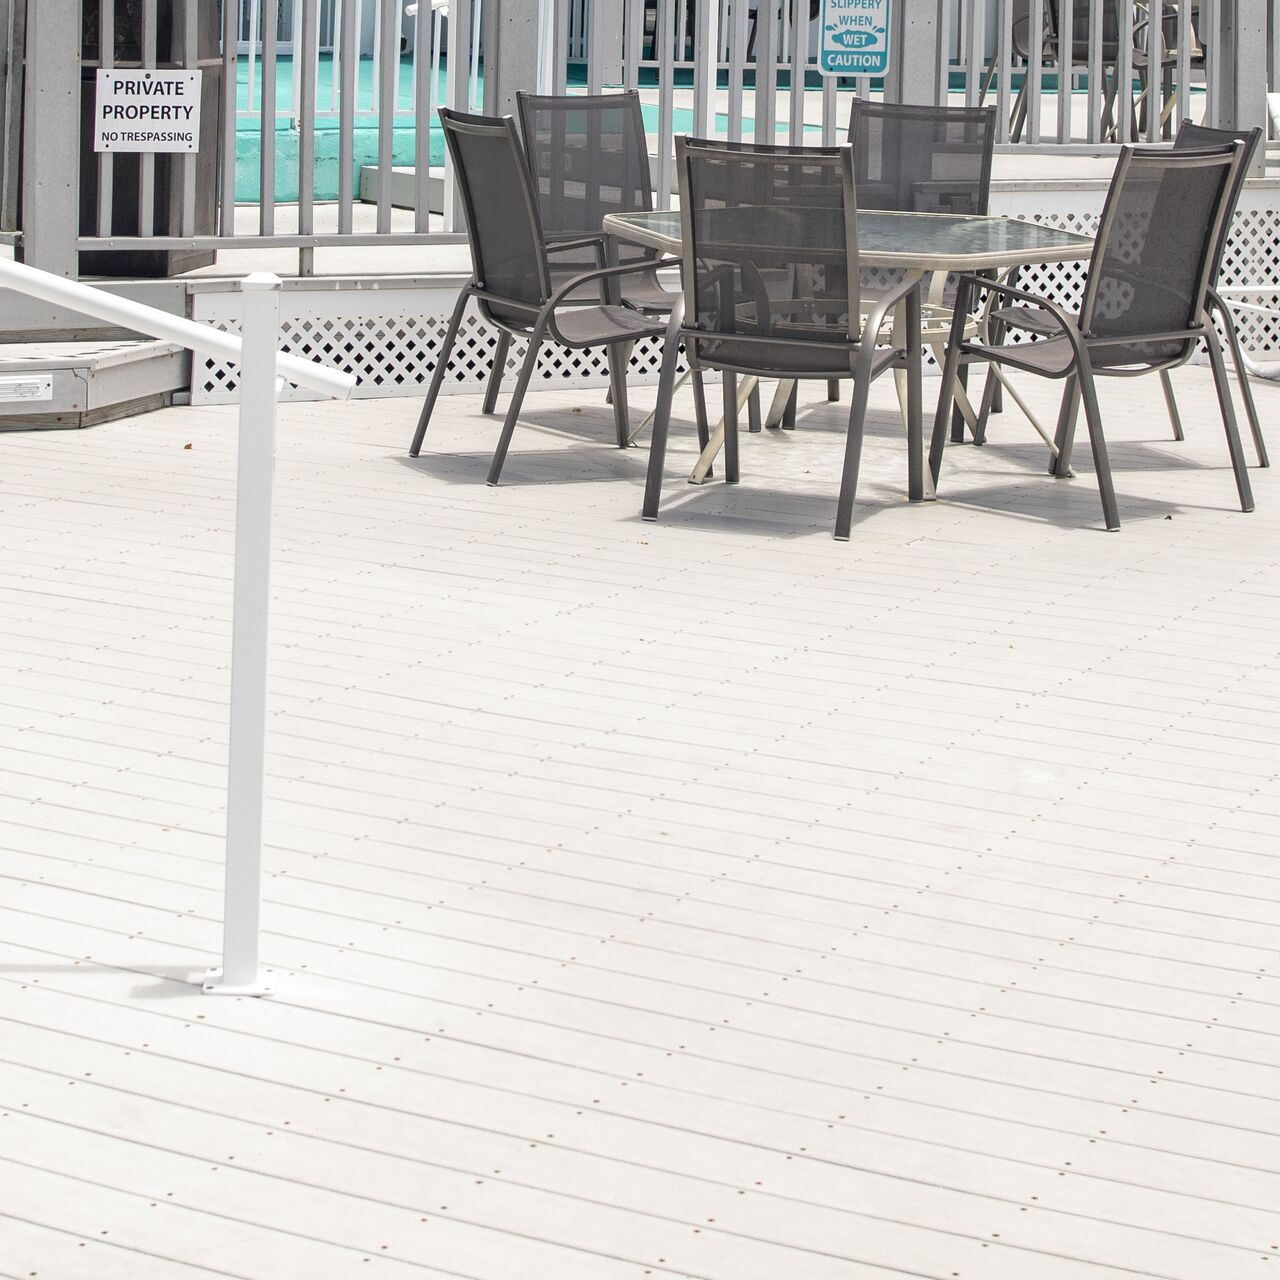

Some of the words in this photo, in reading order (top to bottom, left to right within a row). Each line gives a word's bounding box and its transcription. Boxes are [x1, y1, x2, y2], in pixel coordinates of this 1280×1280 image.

[839, 15, 873, 26] WHEN
[842, 34, 867, 46] WET
[827, 54, 880, 67] CAUTION
[113, 80, 184, 96] PRIVATE
[102, 105, 194, 120] PROPERTY
[102, 132, 118, 141] NO
[121, 132, 193, 142] TRESPASSING
